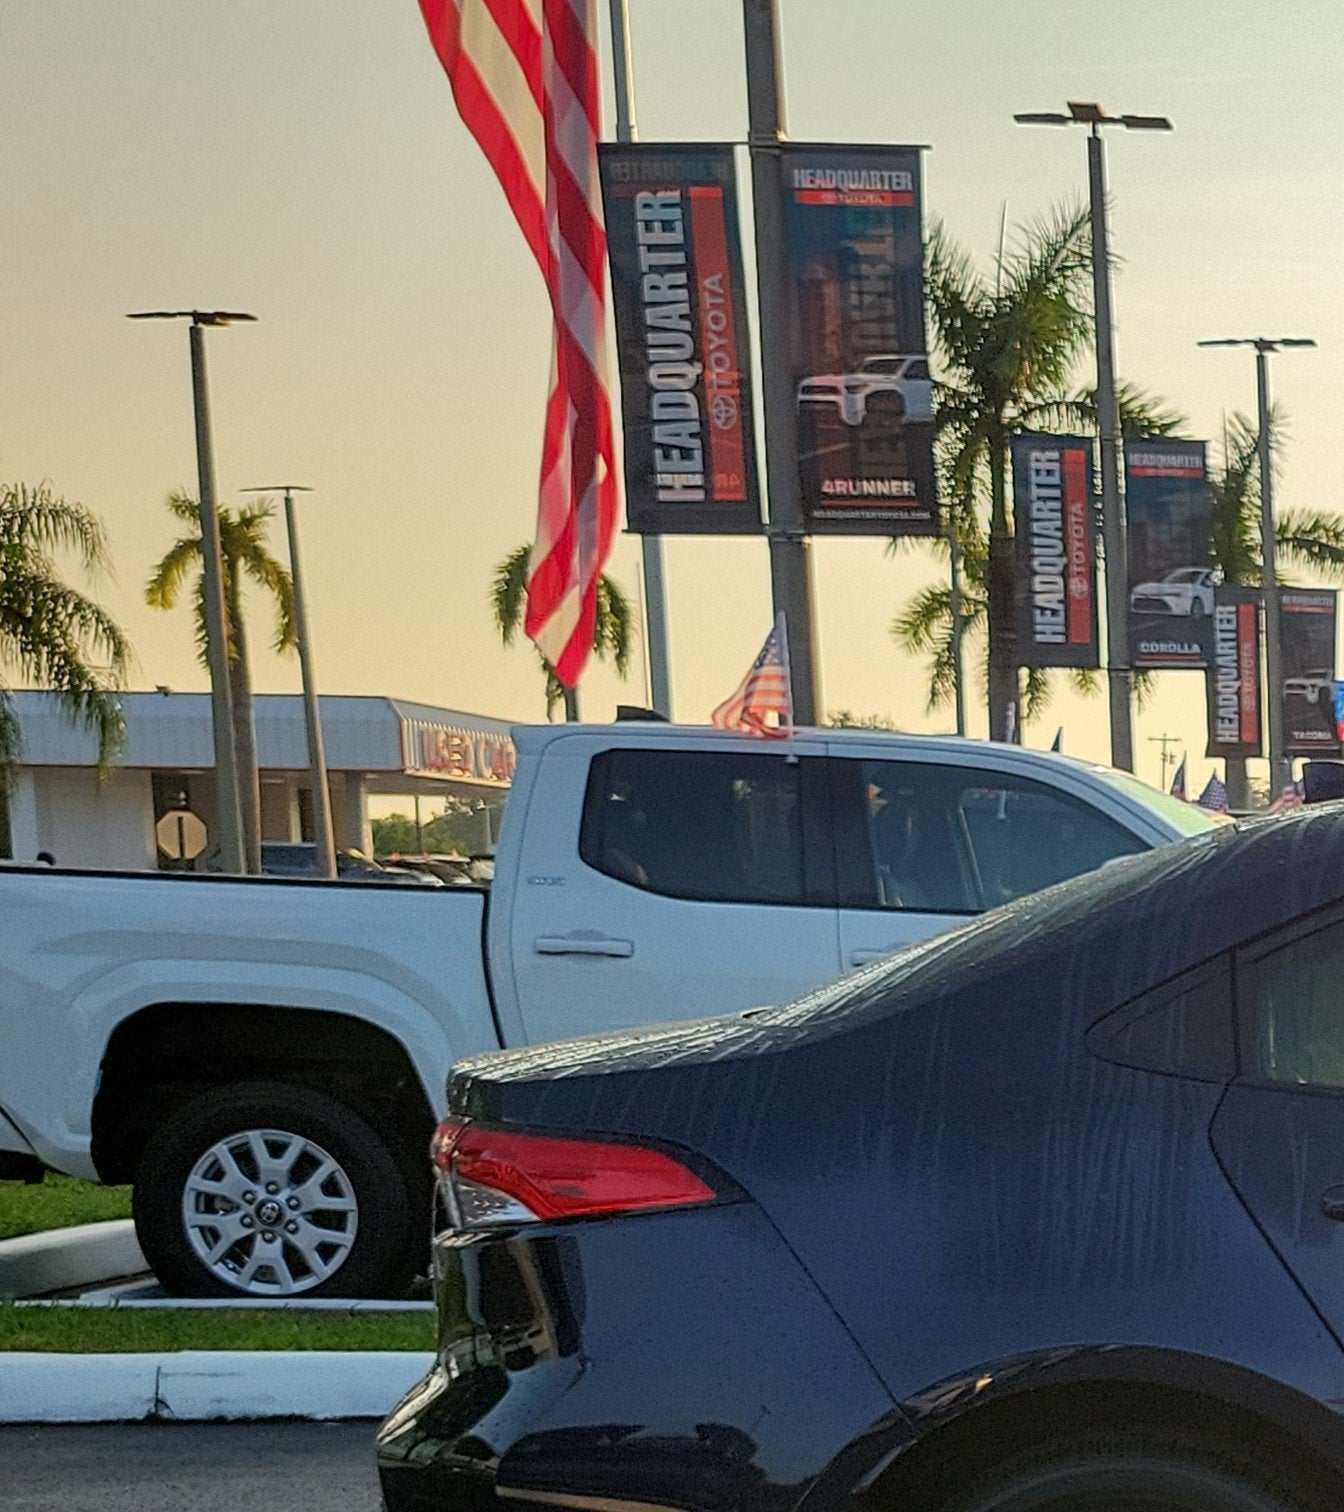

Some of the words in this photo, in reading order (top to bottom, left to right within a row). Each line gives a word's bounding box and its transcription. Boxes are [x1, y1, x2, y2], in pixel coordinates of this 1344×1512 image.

[793, 169, 912, 193] HEADQUARTER
[636, 189, 705, 501] HEADQUARTER
[703, 273, 731, 391] TOYOTA
[821, 479, 916, 496] 4RUNNER
[1029, 451, 1067, 644] HEADQUARTER
[1072, 503, 1086, 575] TOYOTA
[1140, 641, 1202, 653] COROLLA
[1215, 606, 1240, 742] HEADQUARTER
